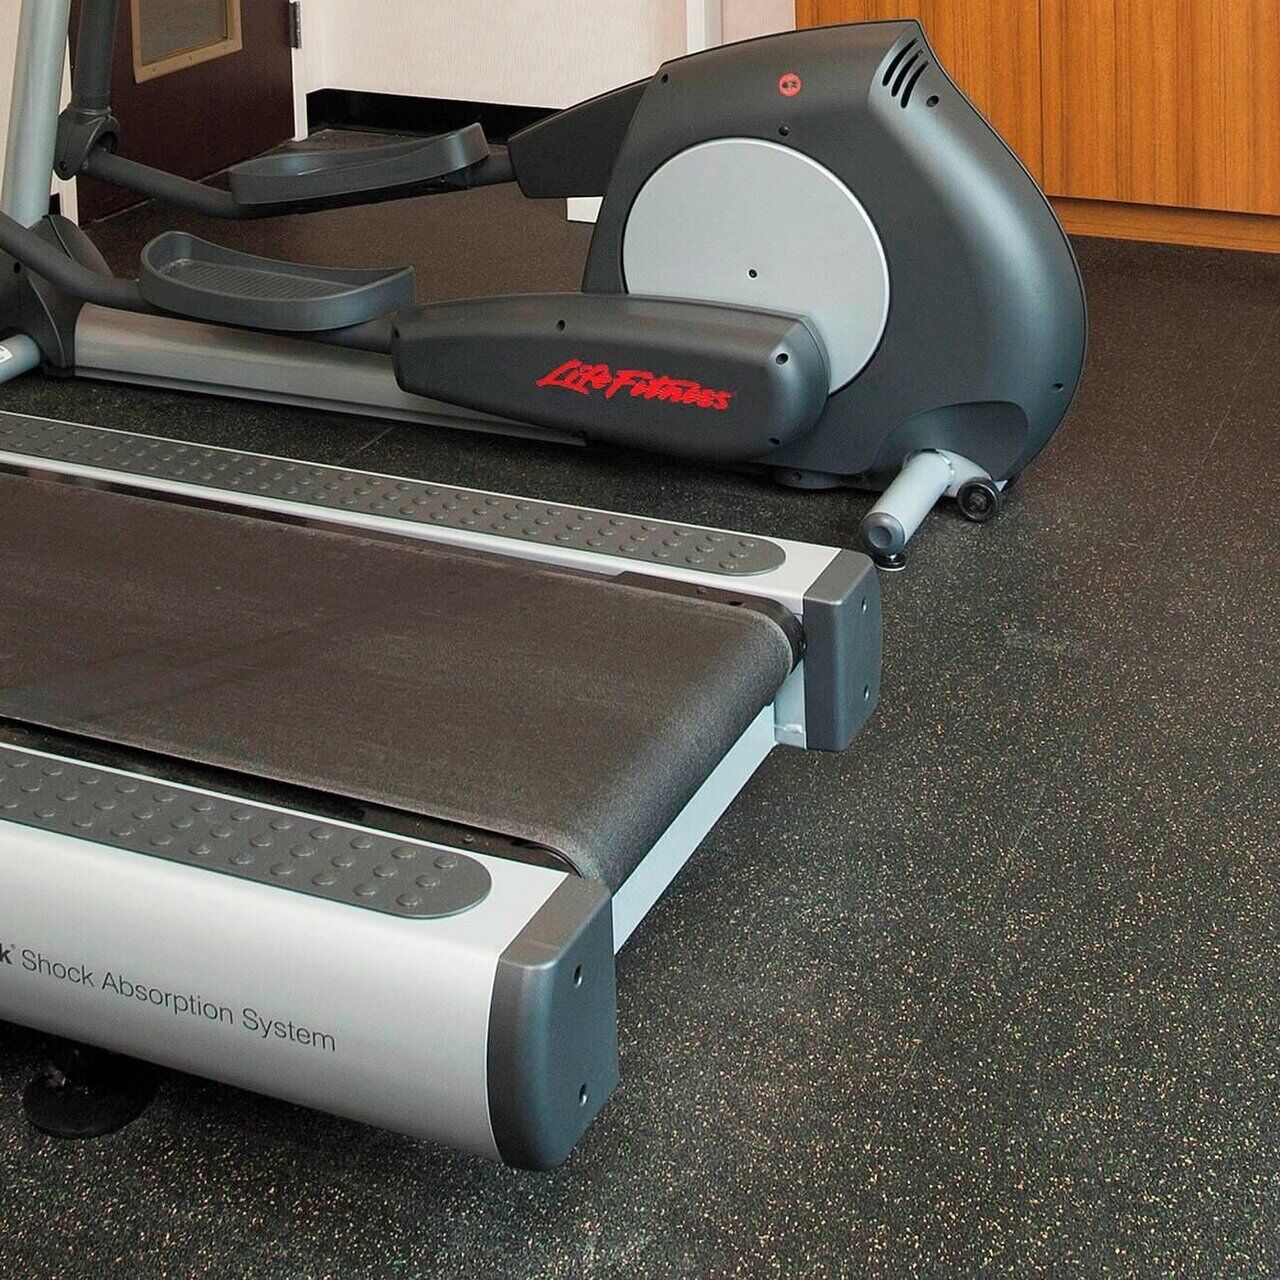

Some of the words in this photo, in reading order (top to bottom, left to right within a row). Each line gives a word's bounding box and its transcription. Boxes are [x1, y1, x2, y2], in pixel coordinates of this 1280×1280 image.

[535, 359, 613, 396] Life
[605, 369, 733, 411] Fitness
[21, 948, 95, 989] Shock
[101, 971, 234, 1025] Absorption
[242, 1007, 337, 1054] System
